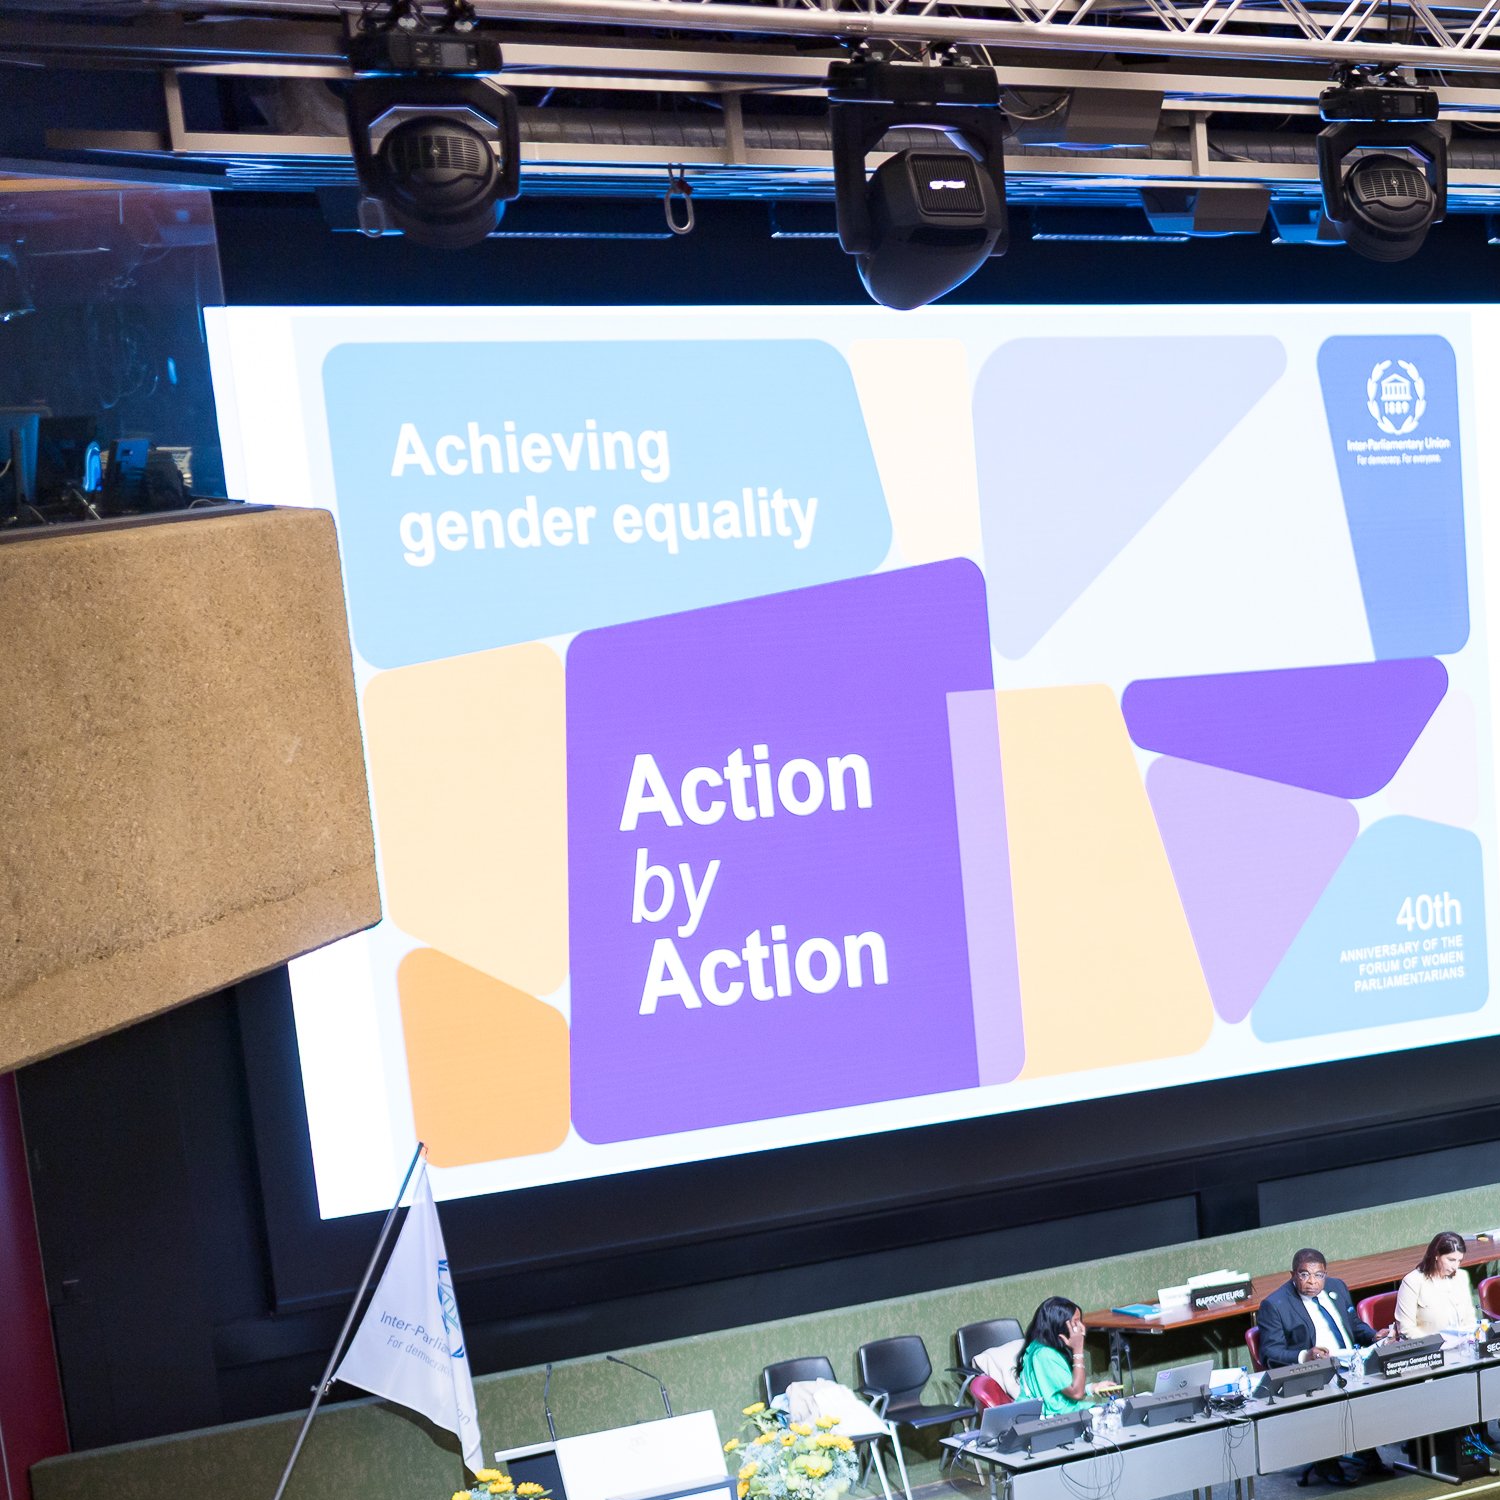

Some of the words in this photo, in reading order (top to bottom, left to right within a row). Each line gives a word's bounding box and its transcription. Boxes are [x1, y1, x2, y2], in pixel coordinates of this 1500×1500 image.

[390, 419, 671, 483] Achieving
[1346, 438, 1424, 453] Inter-Parliamentary
[1424, 436, 1451, 450] Union
[399, 499, 596, 566] gender
[612, 488, 818, 553] equality
[619, 744, 873, 831] Action
[631, 848, 721, 938] by
[1395, 891, 1462, 932] 40th
[1339, 940, 1419, 963] ANNIVERSARY
[1423, 938, 1439, 951] OF
[1441, 934, 1463, 948] THE
[1359, 959, 1400, 976] FORUM
[1403, 956, 1418, 970] OF
[1421, 951, 1464, 967] WOMEN
[638, 925, 889, 1015] Action
[1354, 966, 1465, 992] PARLIAMENTARIANS
[1195, 1289, 1245, 1307] RAPPORTEURS
[380, 1311, 451, 1356] Inter-Parlia
[386, 1335, 403, 1349] For
[405, 1343, 452, 1375] democrac
[1387, 1359, 1409, 1370] Secretary
[1409, 1355, 1428, 1364] General
